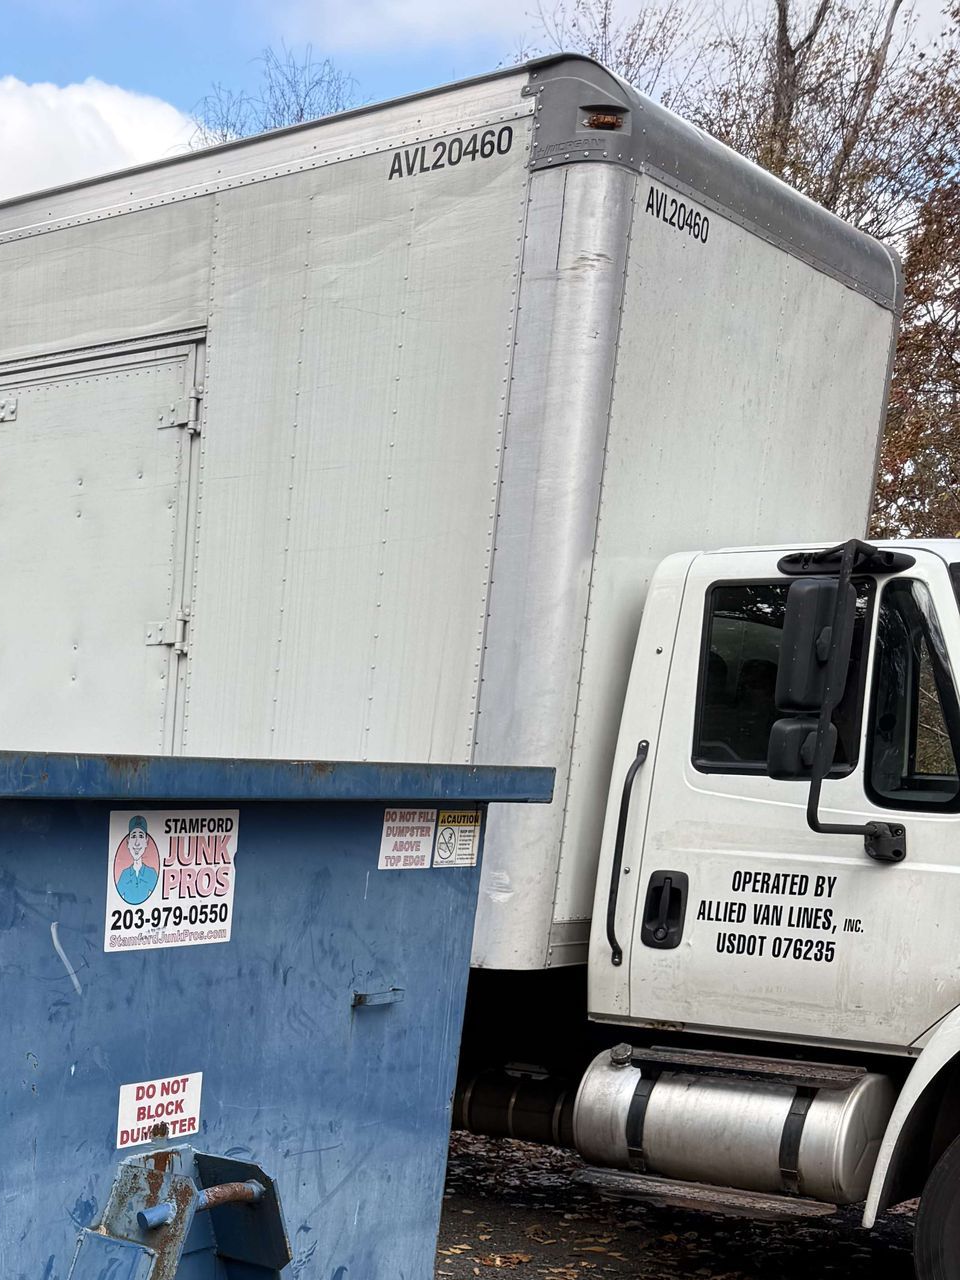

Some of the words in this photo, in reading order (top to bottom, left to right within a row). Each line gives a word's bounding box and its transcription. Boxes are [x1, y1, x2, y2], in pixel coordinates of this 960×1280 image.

[387, 125, 514, 181] AVL20460
[645, 185, 710, 245] AVL20460
[164, 818, 233, 834] STAMFORD
[385, 810, 397, 822] DO
[400, 811, 416, 822] NOT
[419, 811, 435, 822] FILL
[446, 814, 480, 824] CAUTION
[386, 826, 431, 837] DUMPSTER
[163, 835, 232, 867] JUNK
[392, 840, 421, 852] ABOVE
[385, 855, 401, 867] TOP
[402, 855, 426, 867] EDGE
[162, 867, 230, 900] PROS
[732, 870, 809, 896] OPERATED
[814, 875, 837, 898] BY
[111, 903, 228, 931] 203-979-0550
[697, 900, 747, 923] ALLIED
[753, 903, 783, 926] VAN
[787, 906, 837, 934] LINES,
[843, 918, 864, 933] INC.
[109, 928, 227, 948] StamfordJunkPros.com
[716, 932, 767, 956] USDOT
[771, 936, 836, 963] 076235
[136, 1084, 156, 1101] DO
[160, 1078, 189, 1096] NOT
[137, 1099, 184, 1121] BLOCK
[120, 1117, 196, 1145] DUMTER
